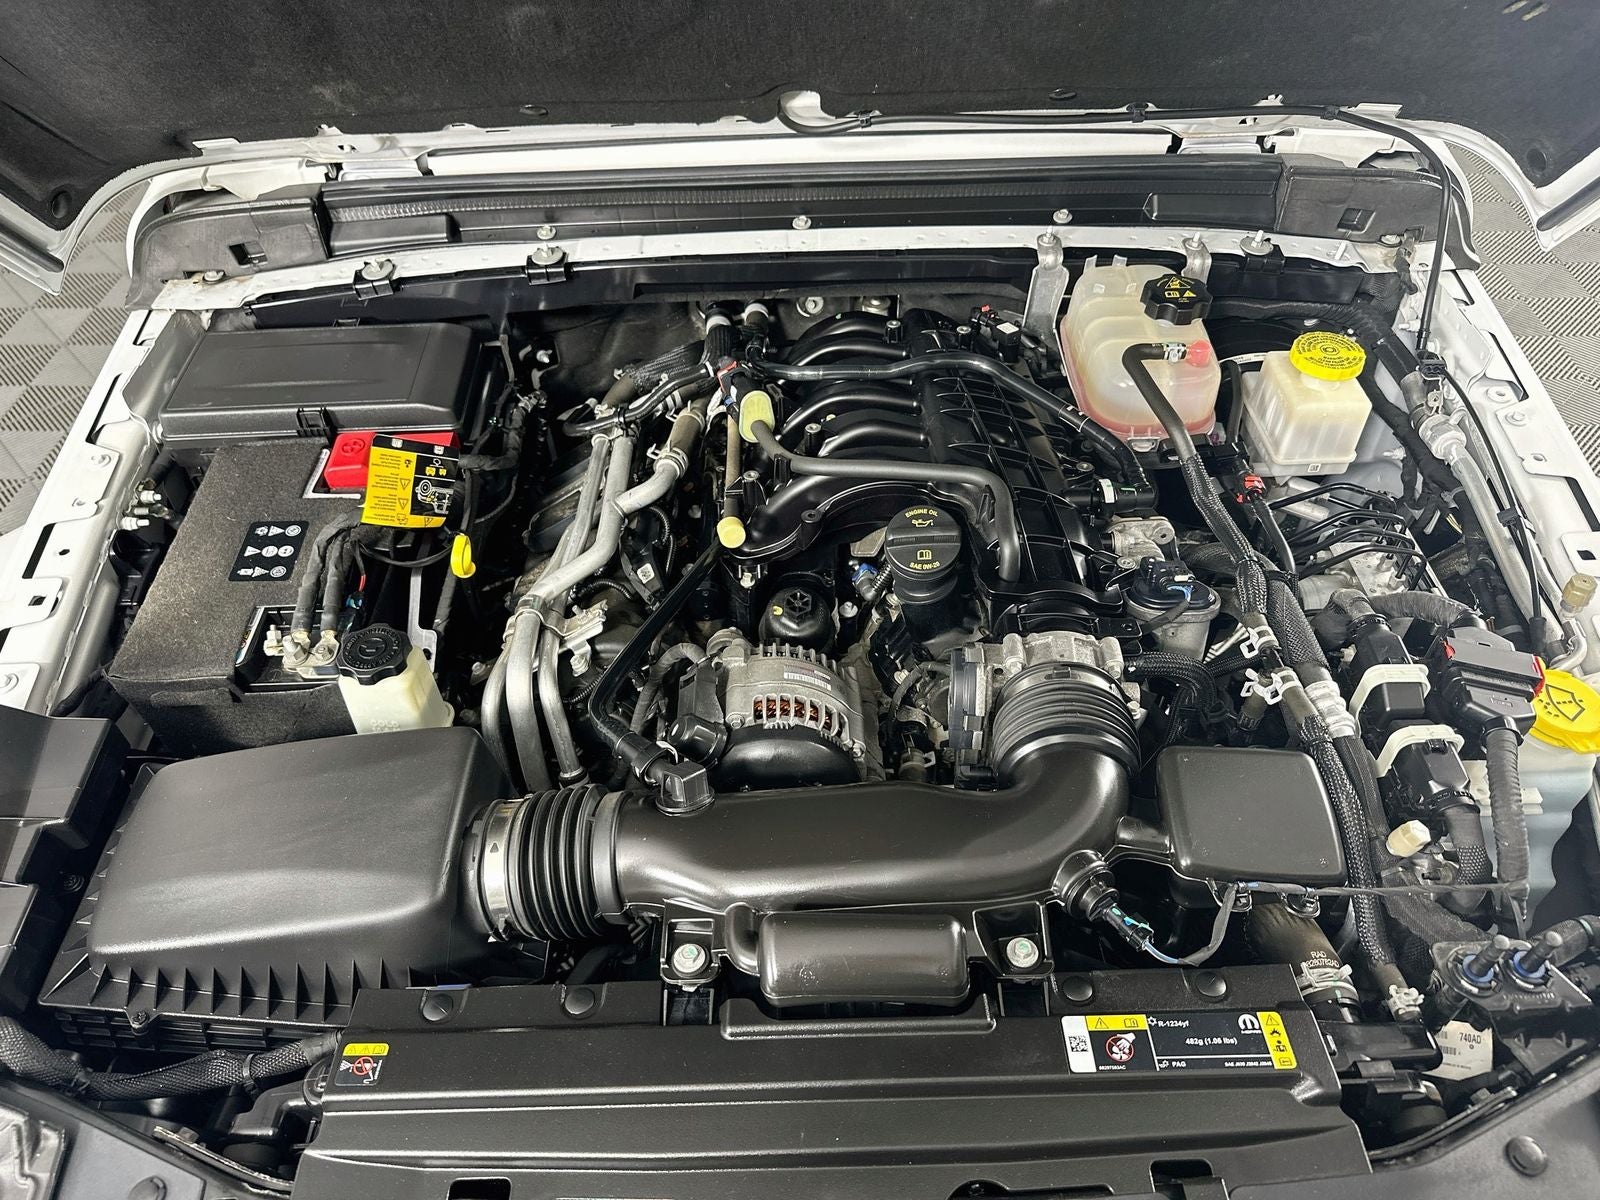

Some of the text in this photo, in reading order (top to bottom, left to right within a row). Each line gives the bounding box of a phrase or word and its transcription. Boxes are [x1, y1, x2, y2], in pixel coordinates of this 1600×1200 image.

[905, 509, 938, 518] ENGINE OIL
[922, 561, 940, 570] 0W-20
[370, 719, 400, 728] COLD
[1310, 950, 1326, 958] RAD
[1185, 1037, 1204, 1046] 482g
[1223, 1037, 1238, 1045] lbs)
[1459, 1032, 1482, 1044] 740AD
